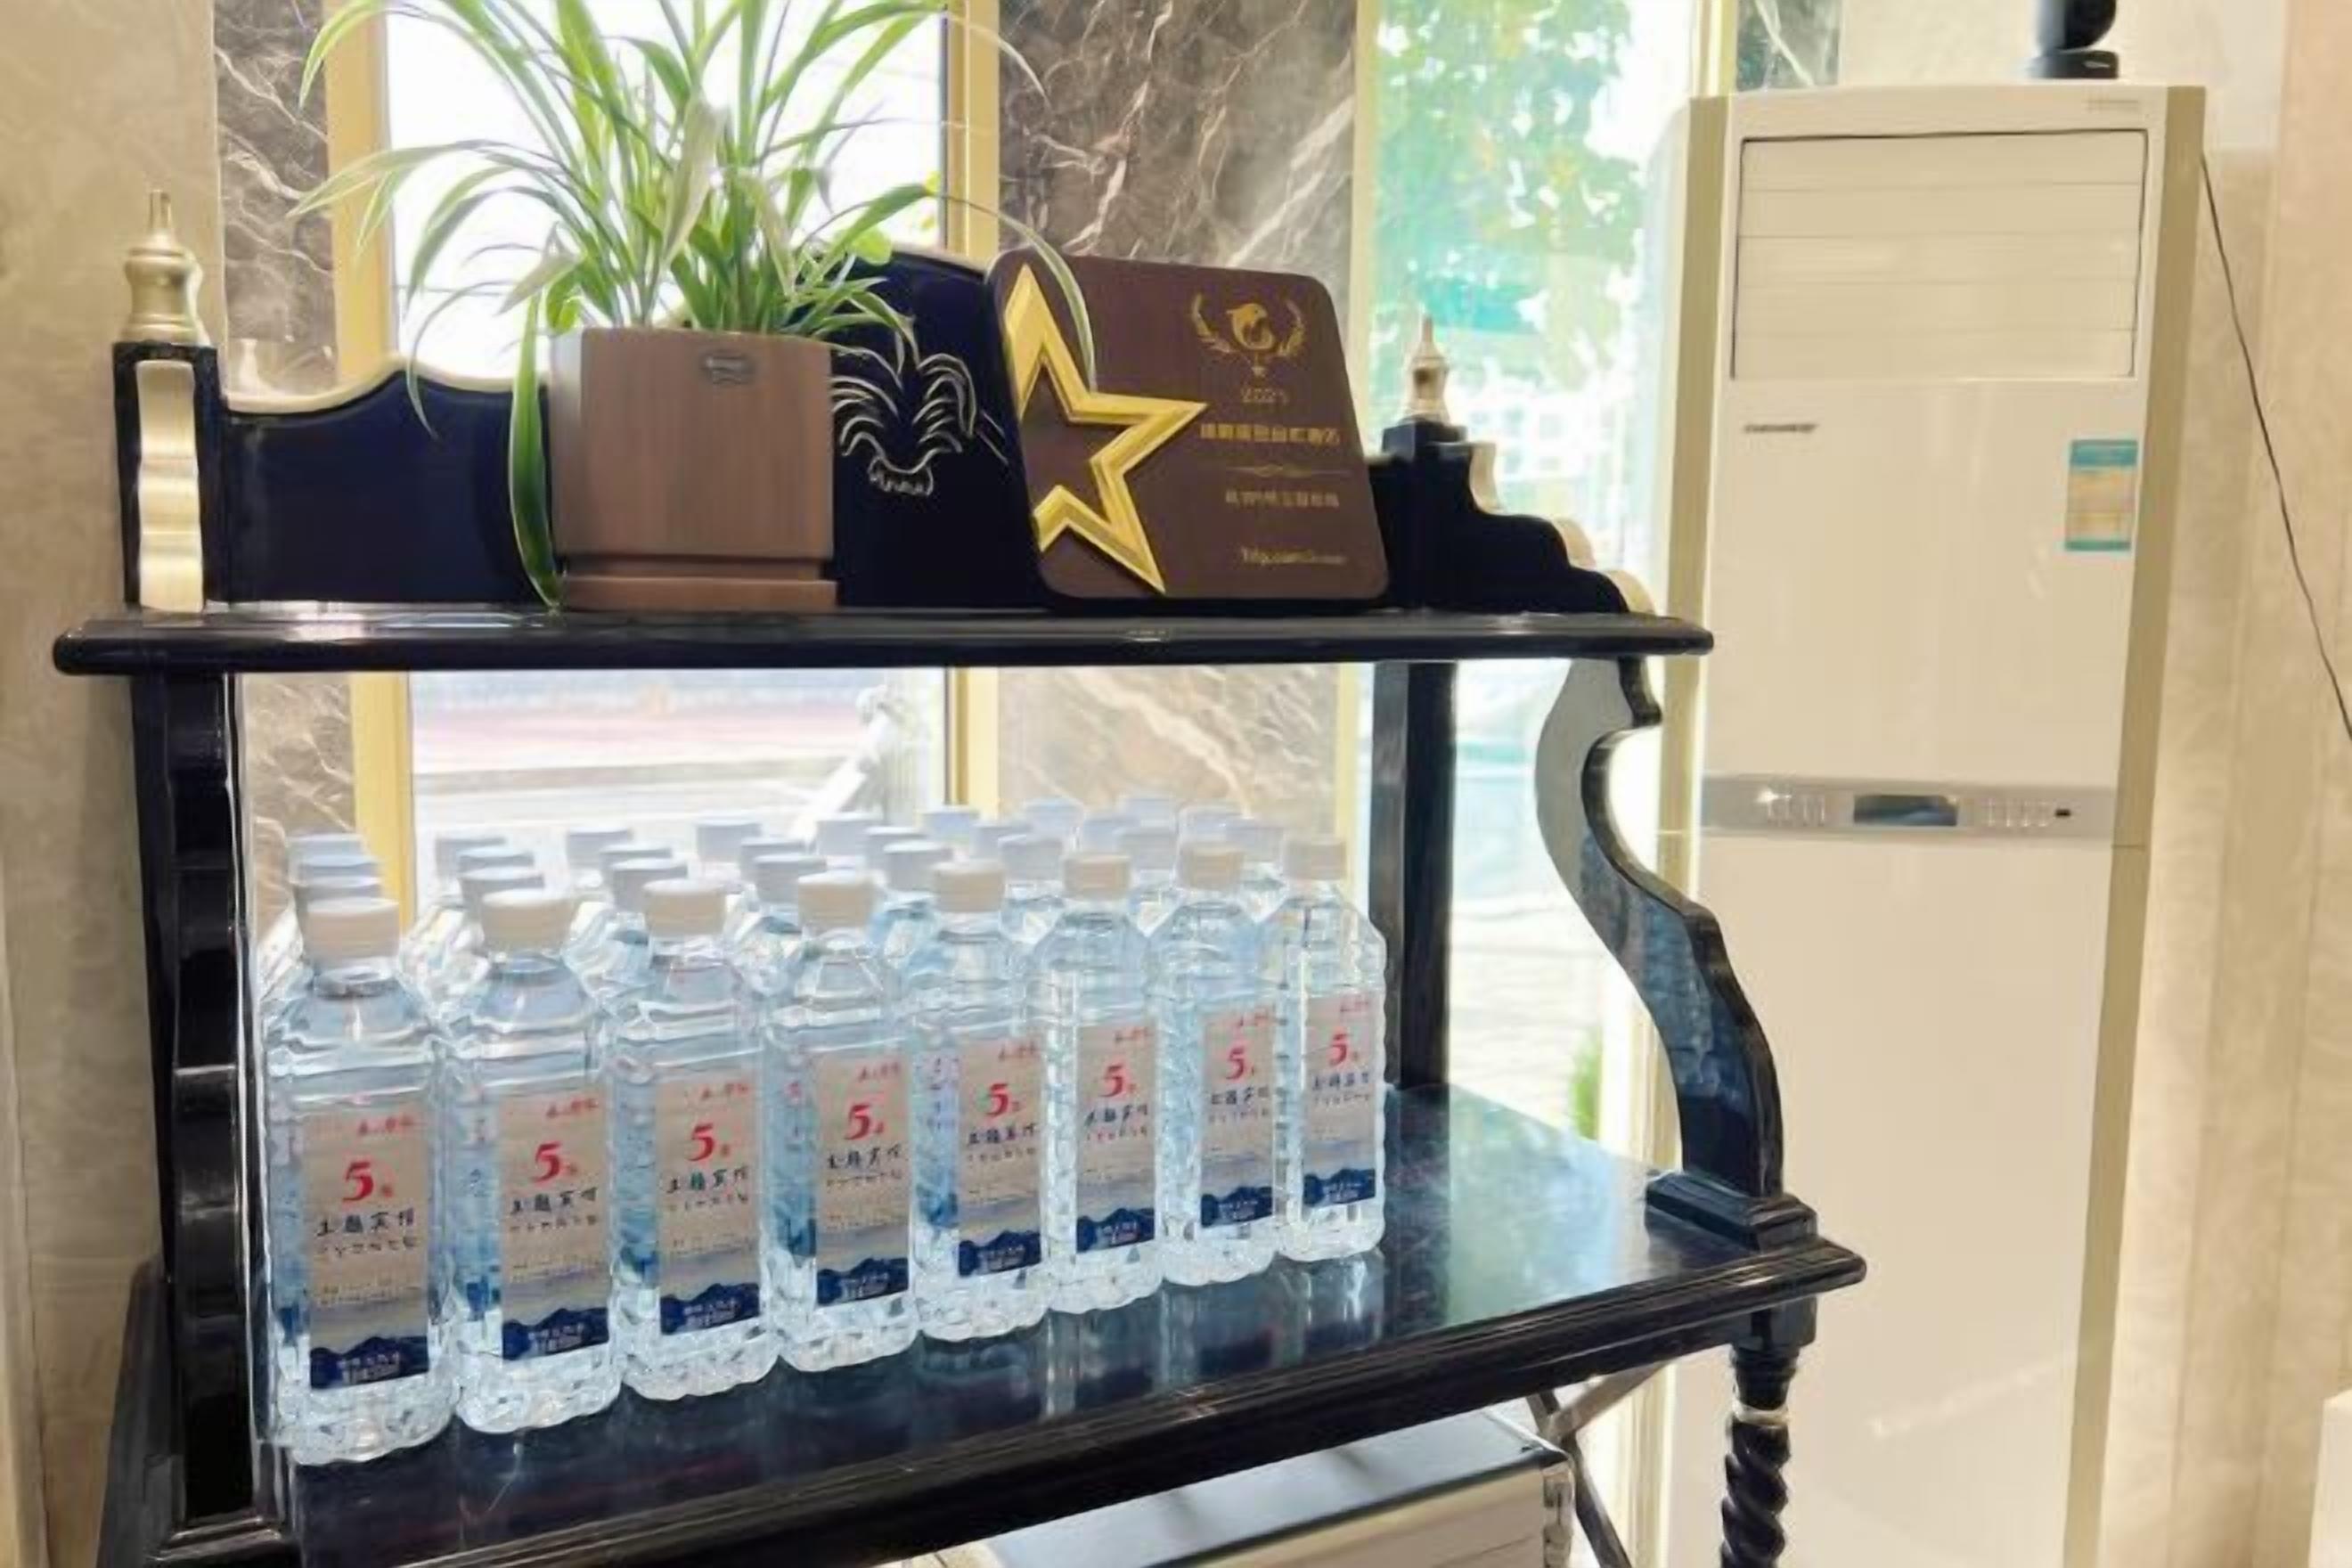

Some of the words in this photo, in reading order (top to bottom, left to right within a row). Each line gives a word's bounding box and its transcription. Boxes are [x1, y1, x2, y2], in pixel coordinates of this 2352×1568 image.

[985, 1083, 1009, 1116] 5
[844, 1104, 870, 1140] 5
[531, 1141, 562, 1183] 5
[686, 1123, 715, 1162] 5
[343, 1161, 374, 1201] 5
